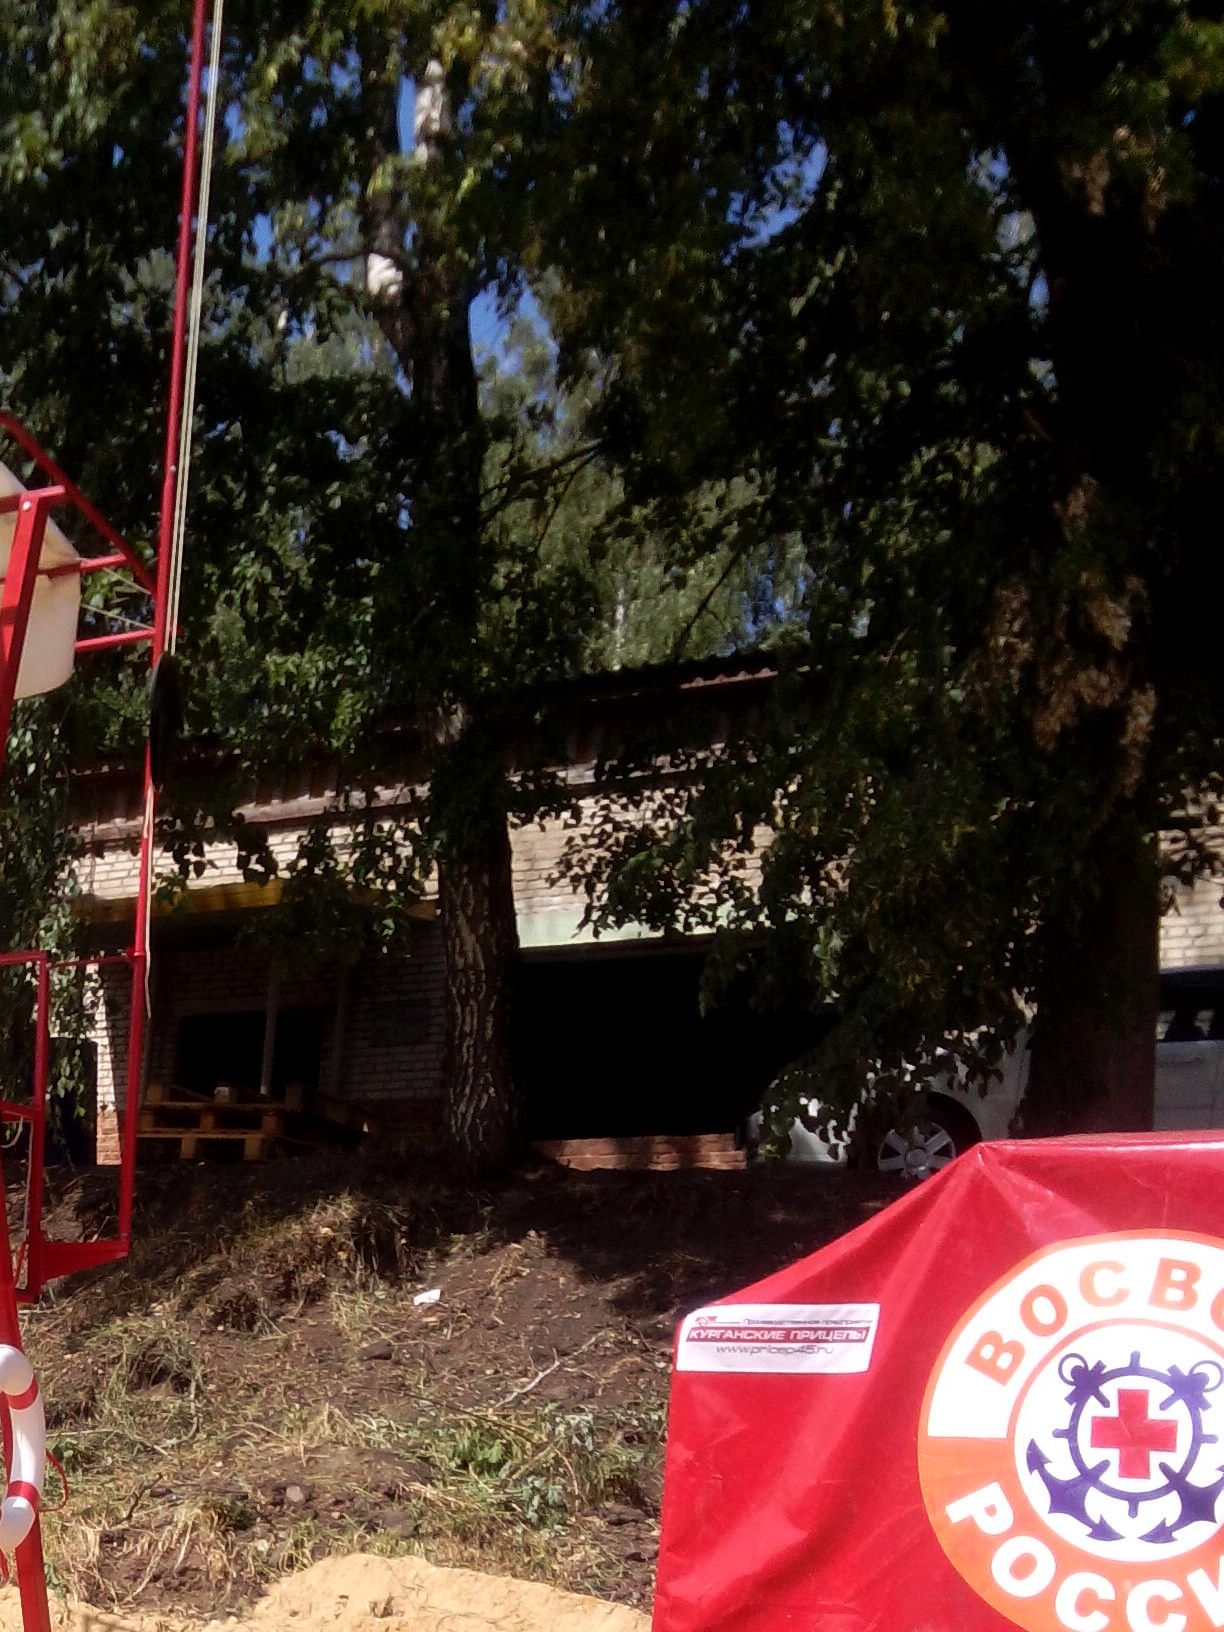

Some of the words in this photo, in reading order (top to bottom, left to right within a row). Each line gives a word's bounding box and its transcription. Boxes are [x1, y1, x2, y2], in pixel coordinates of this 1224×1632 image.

[688, 1329, 786, 1341] КУРГАНСКИЕ
[789, 1329, 868, 1342] ПРИЦЕПЫ
[715, 1344, 835, 1356] www.pricep45.ru
